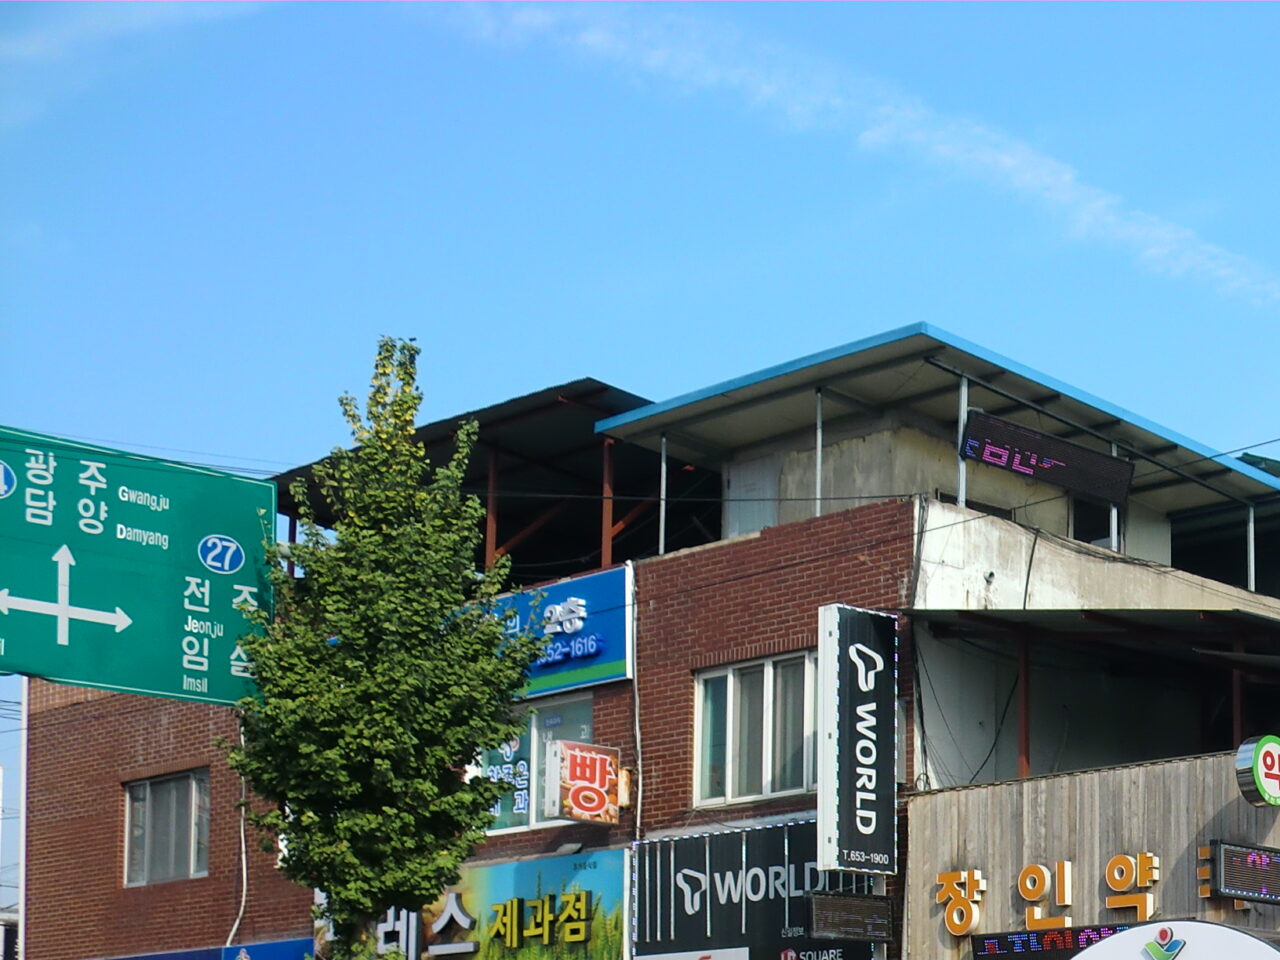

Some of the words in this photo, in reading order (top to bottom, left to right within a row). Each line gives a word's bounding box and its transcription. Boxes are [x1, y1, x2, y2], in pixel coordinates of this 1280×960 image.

[25, 448, 107, 495] 광주
[25, 487, 108, 535] 담양
[118, 486, 169, 511] Gwangju
[117, 524, 169, 550] Damyang
[206, 538, 236, 571] 27
[183, 576, 258, 617] 전주
[544, 597, 588, 634] 2층
[184, 615, 223, 638] Jeonju
[183, 675, 208, 692] Imsil
[567, 748, 616, 814] 빵
[855, 701, 877, 835] WORLD
[842, 849, 889, 865] T.653-1900
[713, 861, 824, 905] WORLD
[936, 848, 1250, 936] 장인약
[490, 890, 592, 948] 제과점
[781, 926, 805, 938] 신일정보
